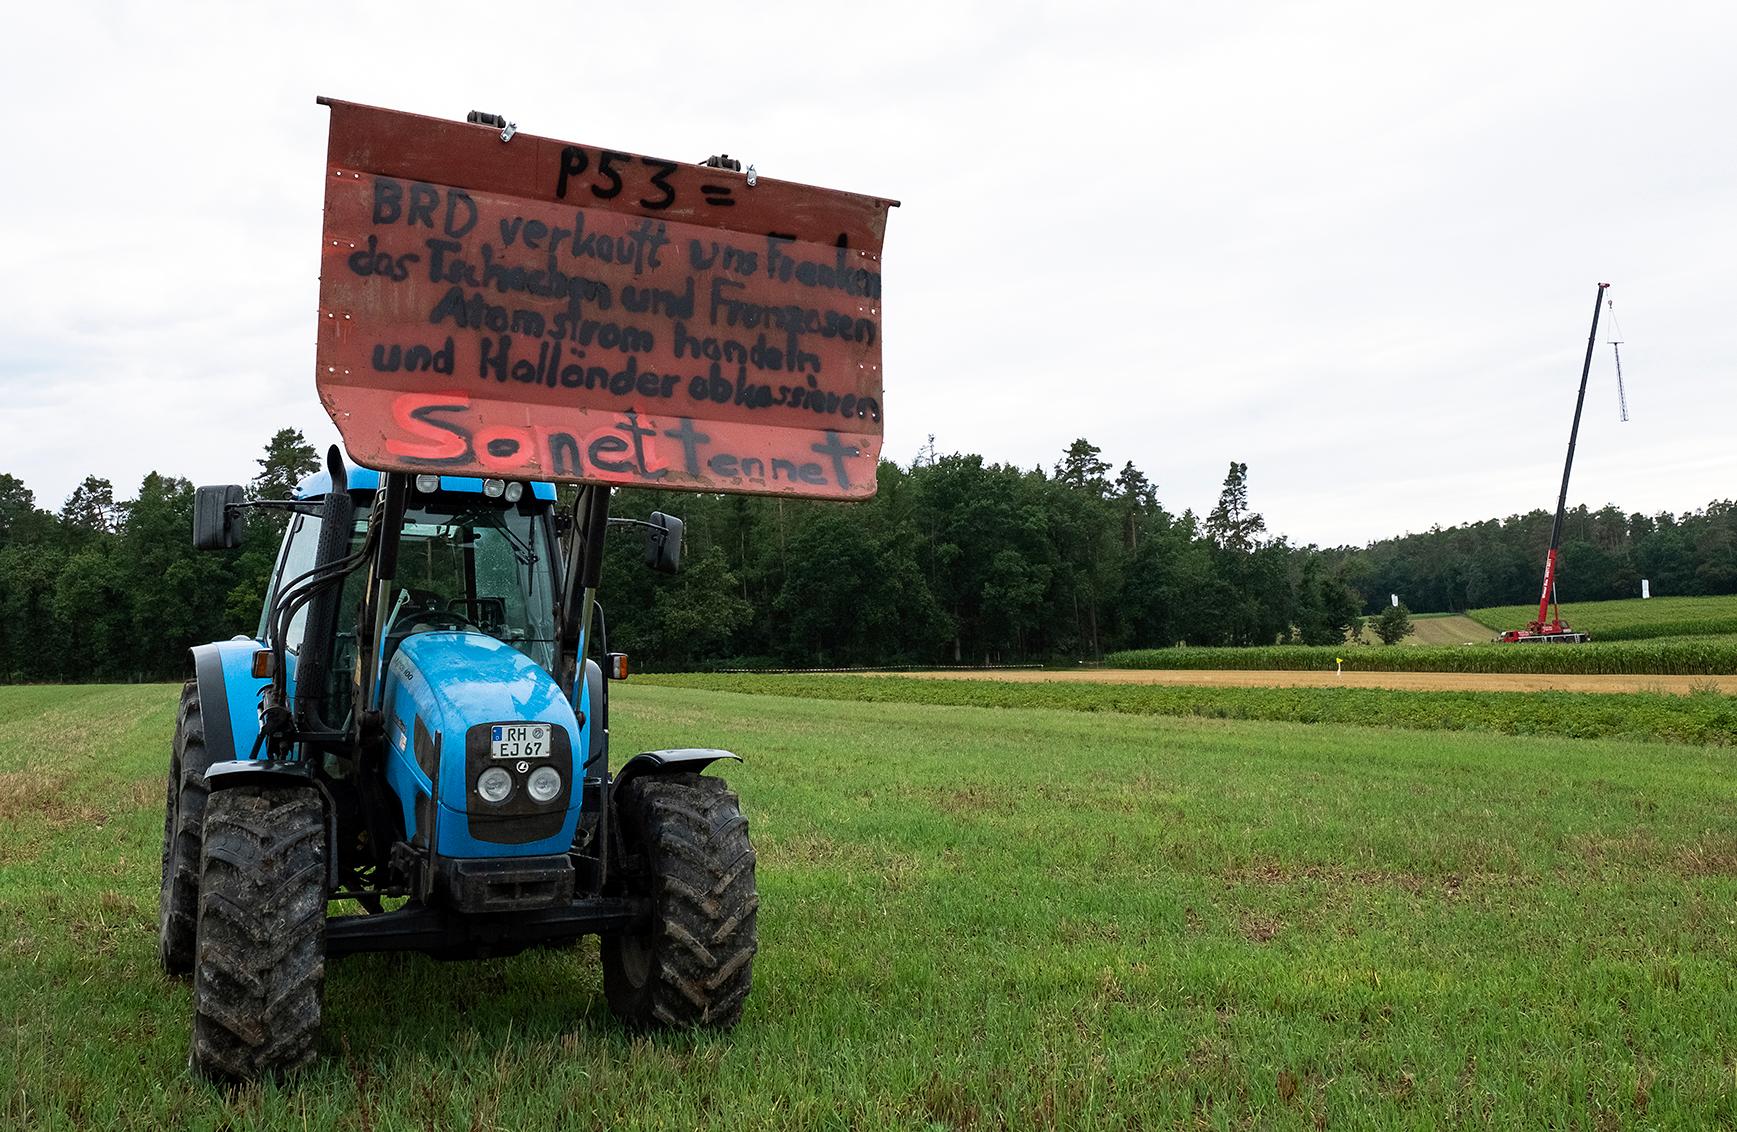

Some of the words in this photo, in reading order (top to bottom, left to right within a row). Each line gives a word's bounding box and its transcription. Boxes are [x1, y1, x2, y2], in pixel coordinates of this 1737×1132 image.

[556, 146, 679, 210] P53
[372, 176, 478, 238] BRD
[500, 210, 671, 275] verkauft
[348, 234, 420, 282] das
[621, 276, 695, 320] und
[372, 336, 455, 375] und
[429, 286, 655, 353] Atomstrom
[674, 320, 822, 374] handeln
[500, 742, 519, 757] EJ
[524, 742, 542, 756] 67
[507, 727, 527, 742] RH
